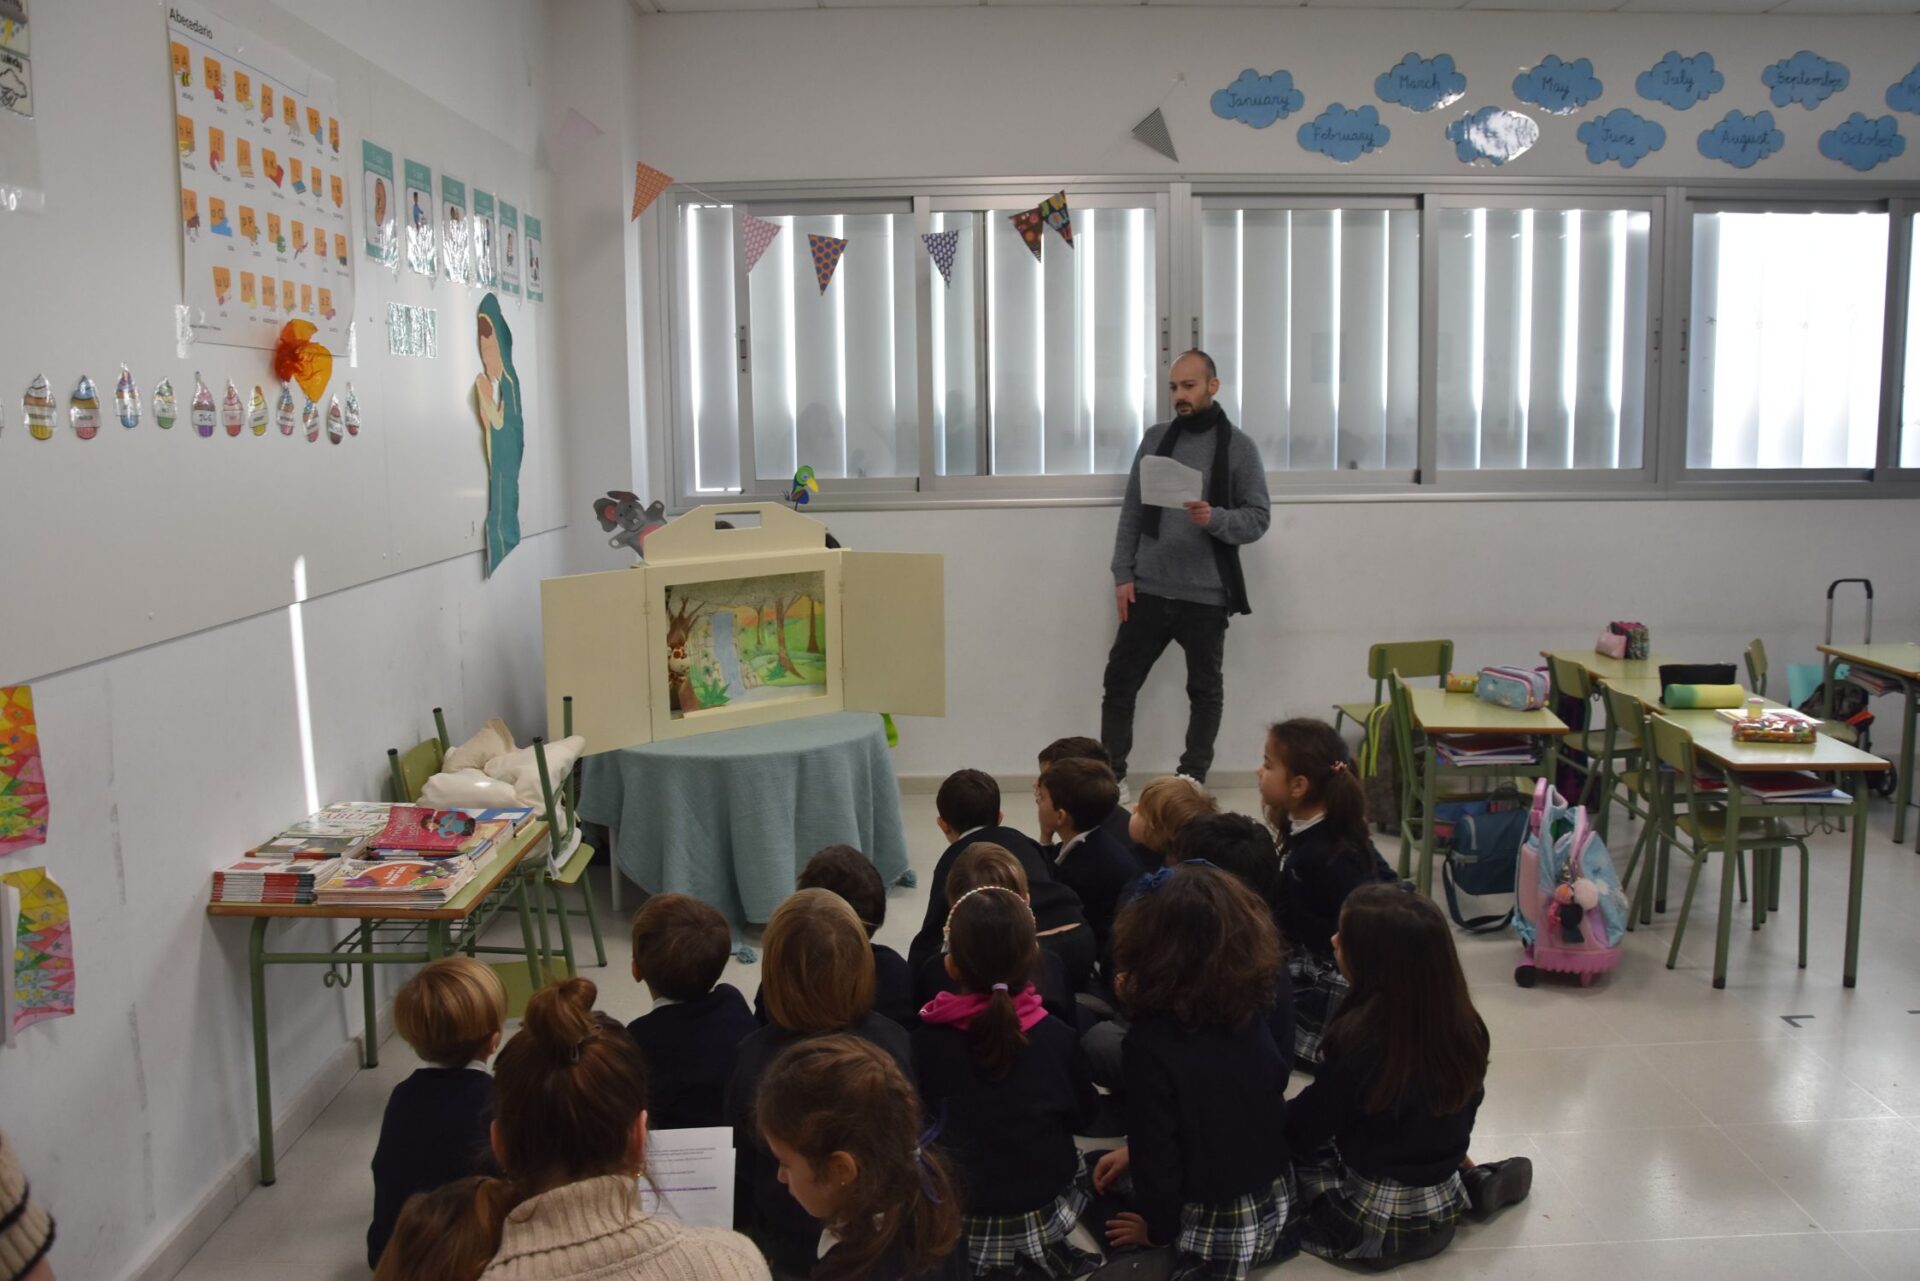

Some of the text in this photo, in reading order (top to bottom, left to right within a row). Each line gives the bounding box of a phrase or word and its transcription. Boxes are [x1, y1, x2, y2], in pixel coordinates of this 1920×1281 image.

[169, 8, 213, 39] Abecedario
[1400, 72, 1441, 90] March
[1542, 76, 1570, 99] May
[1663, 69, 1695, 93] July
[1228, 92, 1290, 111] January
[1313, 127, 1376, 147] February
[1601, 128, 1636, 146] June
[1720, 131, 1771, 153] August
